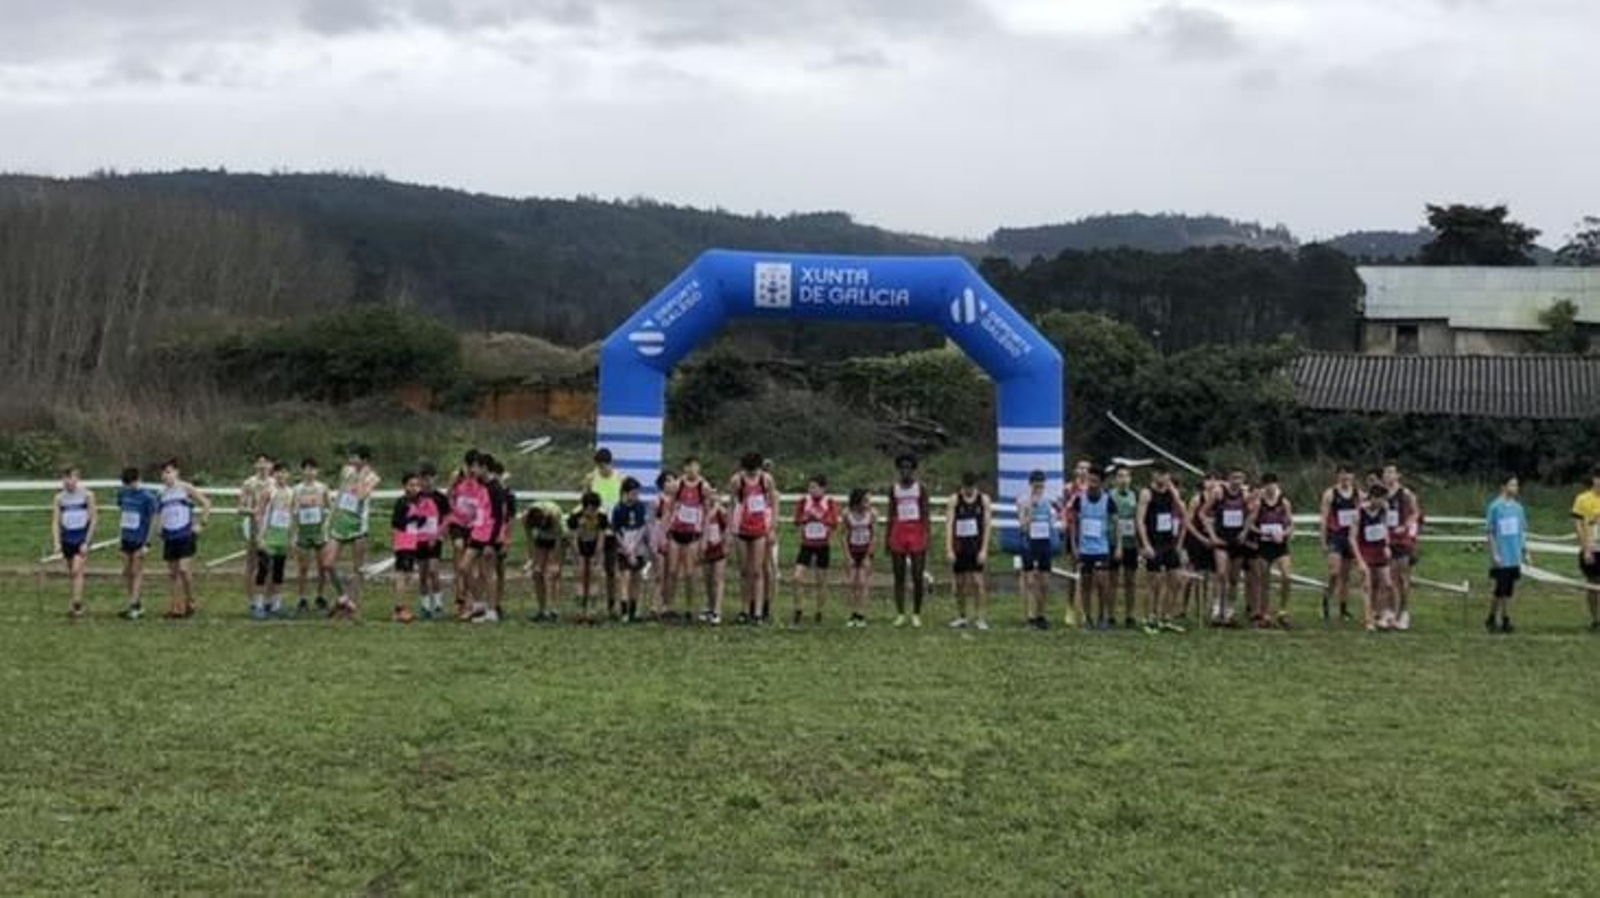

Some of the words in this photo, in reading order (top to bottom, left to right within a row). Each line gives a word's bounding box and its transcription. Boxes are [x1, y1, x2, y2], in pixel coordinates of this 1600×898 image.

[801, 267, 869, 285] XUNTA
[799, 285, 826, 303] DE
[828, 287, 910, 306] GALICIA
